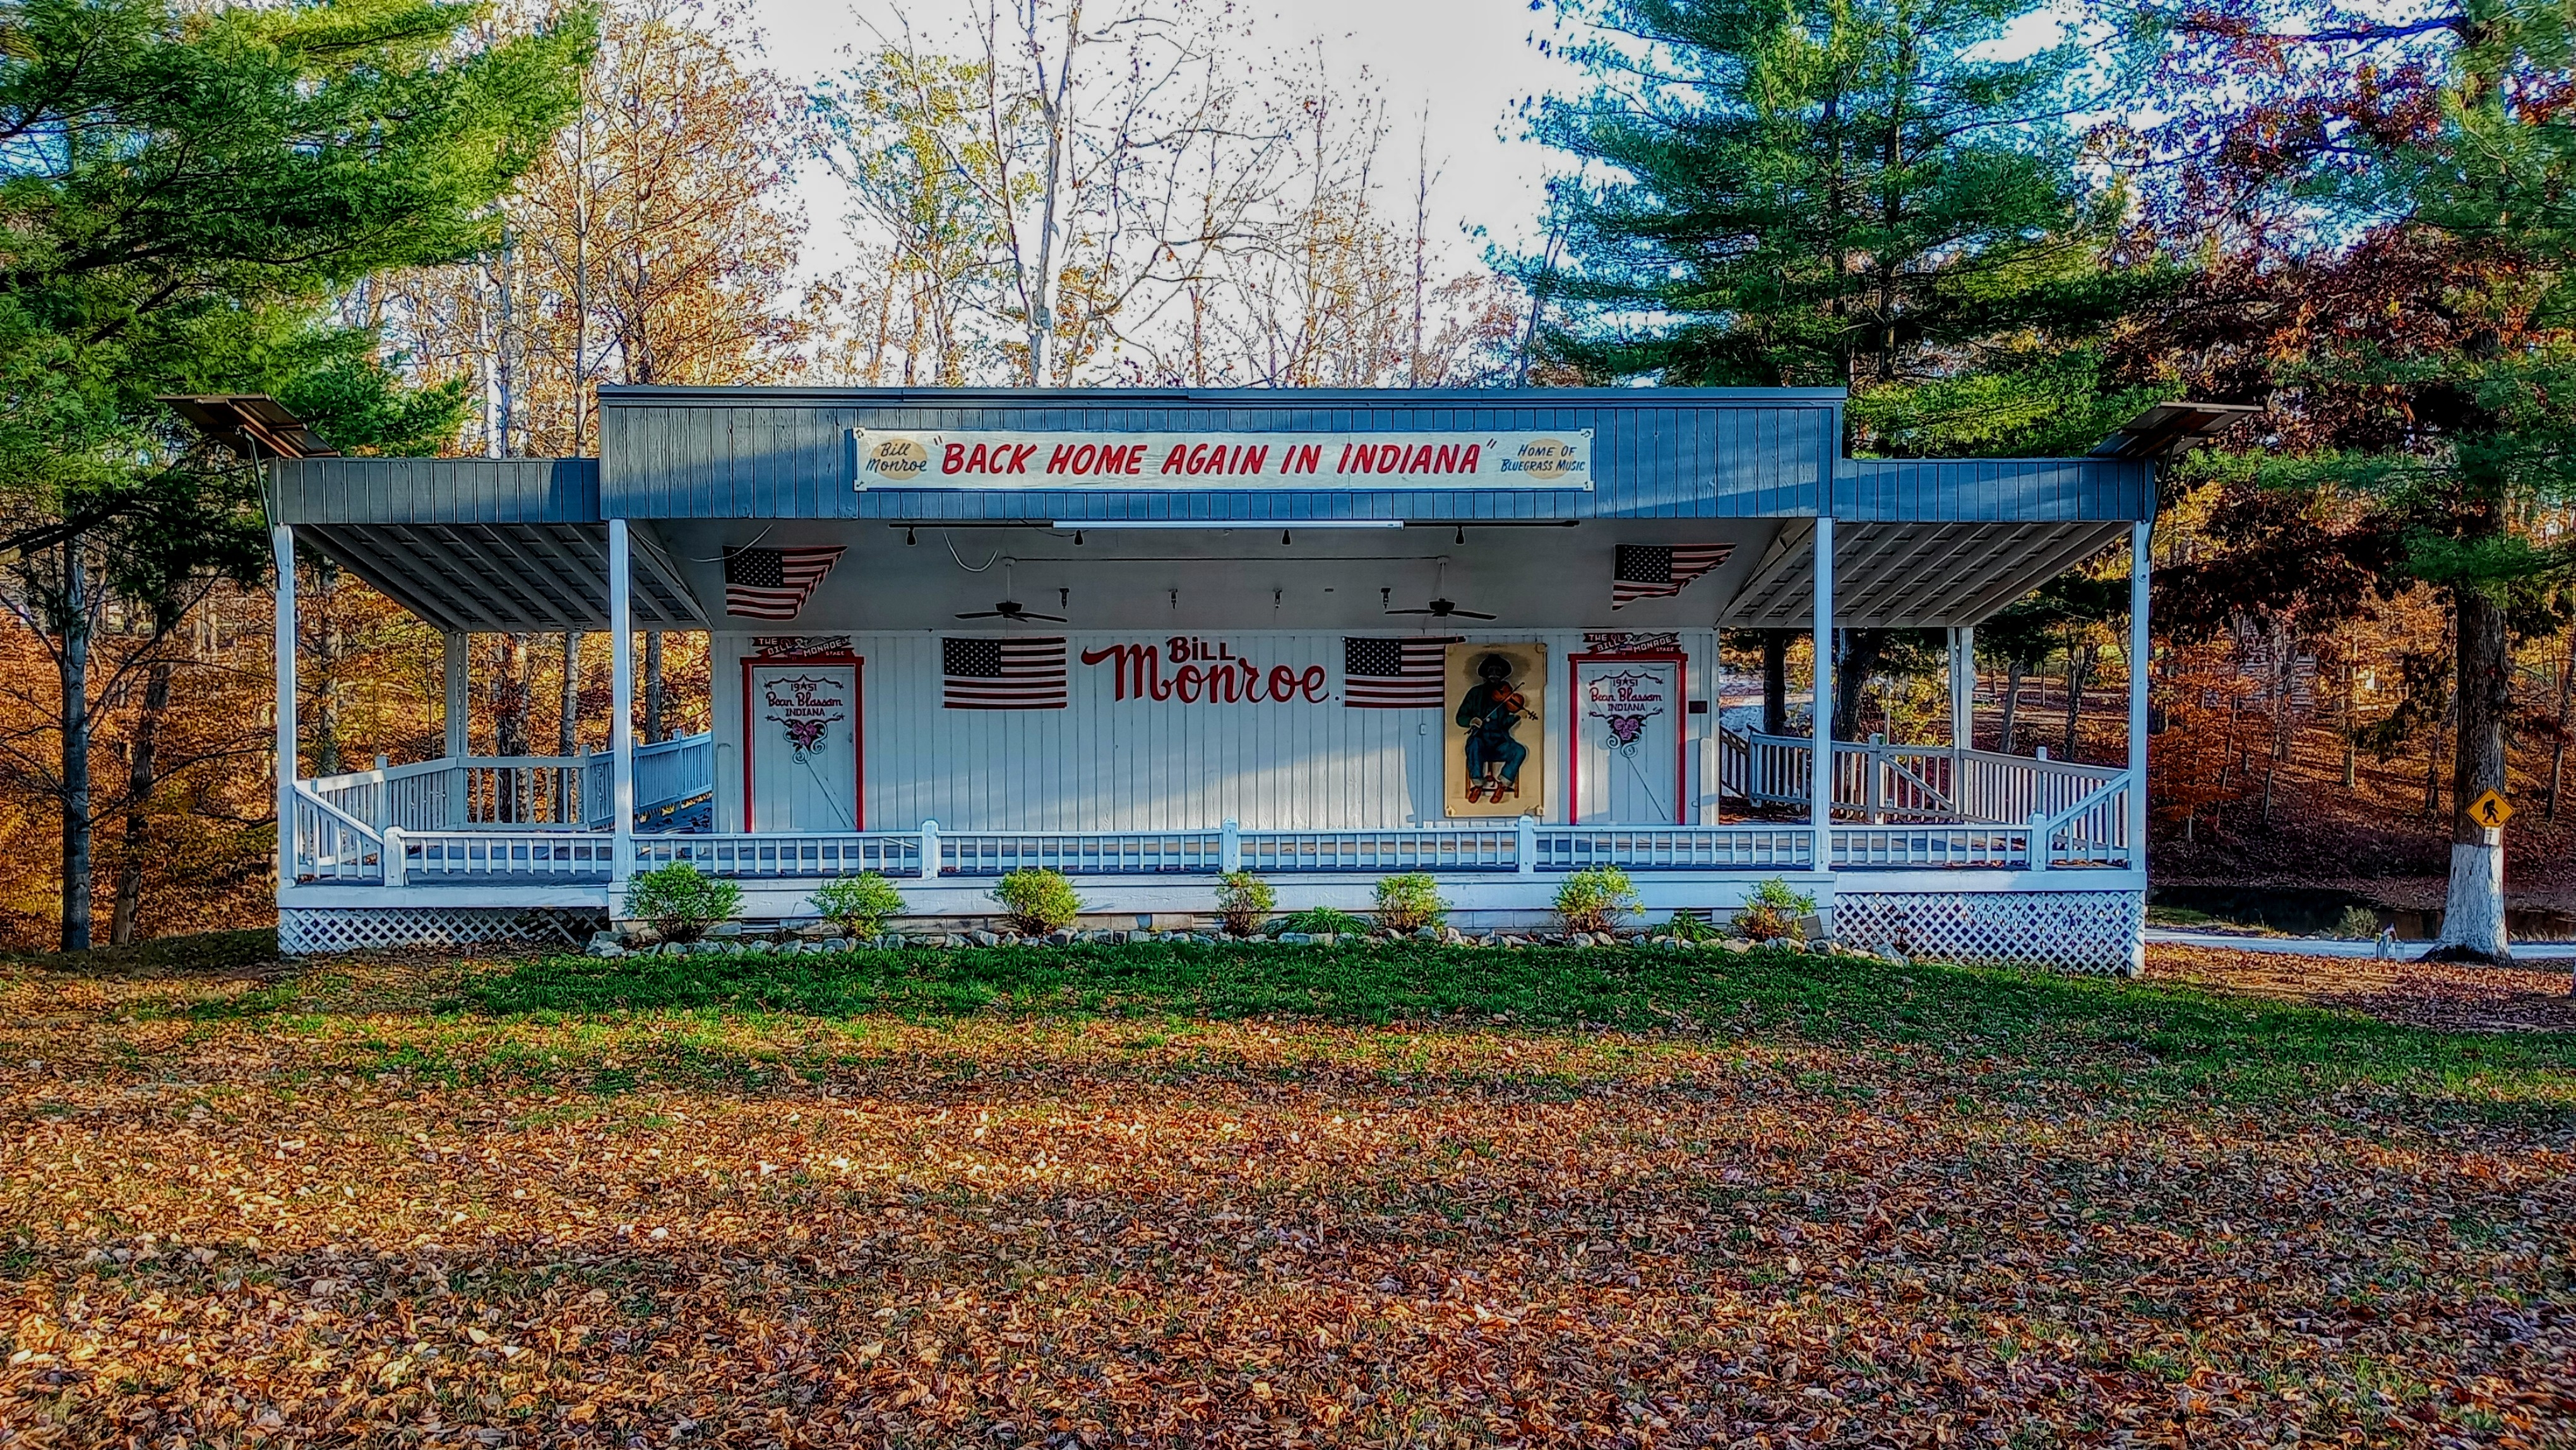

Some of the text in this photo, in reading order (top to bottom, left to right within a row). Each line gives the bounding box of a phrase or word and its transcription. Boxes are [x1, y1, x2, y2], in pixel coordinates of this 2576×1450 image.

[880, 443, 911, 457] Bill
[1518, 444, 1577, 457] HOME OF
[866, 457, 927, 473] Monroe
[1046, 444, 1148, 475] HOME
[1160, 444, 1268, 475] AGAIN
[1280, 445, 1321, 475] IN
[1500, 458, 1585, 472] BLUEGRASS MUSIC
[1081, 643, 1330, 704] Monroe
[785, 708, 825, 716] INDIANA
